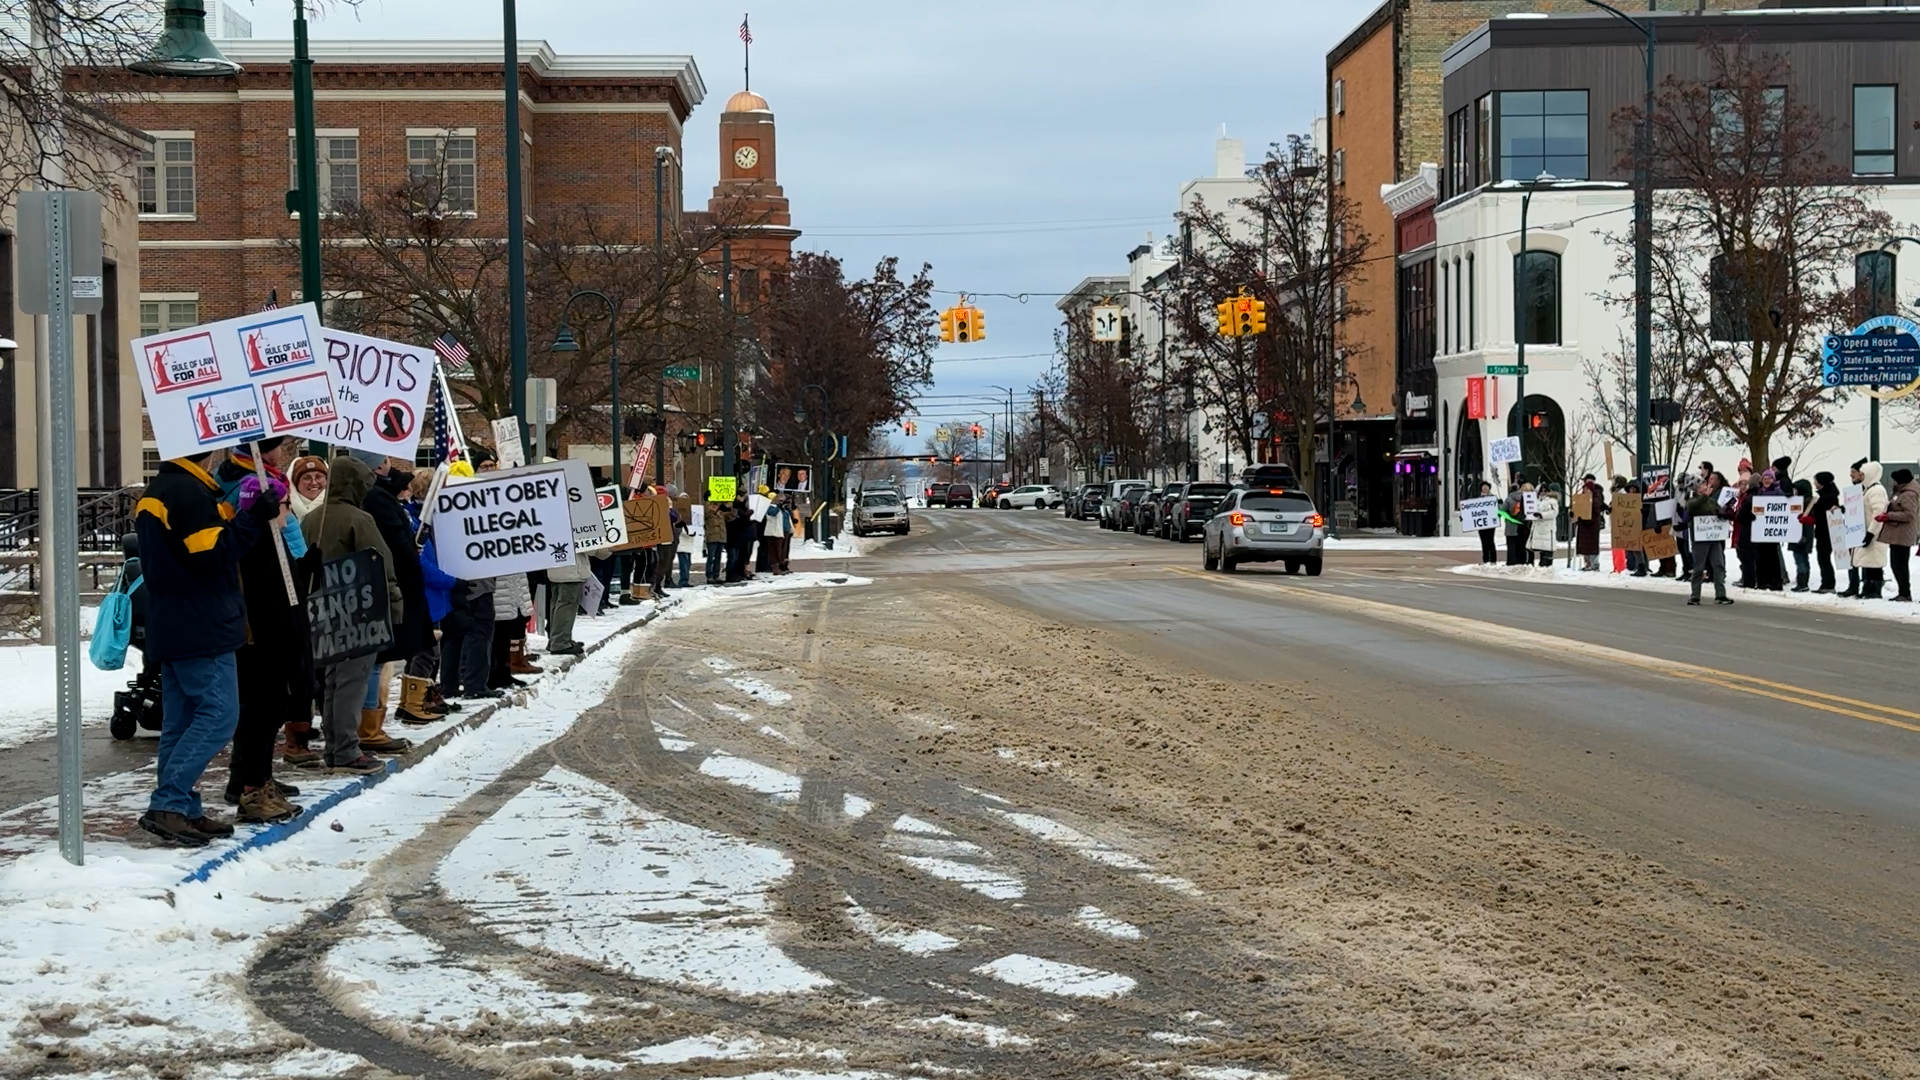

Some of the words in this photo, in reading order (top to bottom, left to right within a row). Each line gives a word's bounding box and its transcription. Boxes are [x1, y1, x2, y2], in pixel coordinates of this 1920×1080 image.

[264, 345, 282, 355] RULE
[282, 343, 291, 352] OF
[292, 340, 308, 349] LAW
[1843, 338, 1869, 349] Opera
[1872, 337, 1898, 347] House
[267, 353, 288, 365] FOR
[290, 349, 311, 361] ALL
[1843, 355, 1883, 365] State/Bijou
[1883, 354, 1915, 364] Theatres
[171, 362, 188, 372] RULE
[189, 361, 198, 369] OF
[198, 357, 215, 367] LAW
[323, 337, 420, 392] RIOTS
[174, 370, 195, 383] FOR
[197, 366, 218, 378] ALL
[1843, 371, 1912, 383] Beaches/Marina
[338, 385, 360, 403] the
[288, 402, 305, 411] RULE
[306, 400, 315, 408] OF
[315, 396, 331, 406] LAW
[214, 414, 232, 423] RULE
[232, 412, 241, 421] OF
[241, 409, 257, 418] LAW
[290, 409, 312, 422] FOR
[313, 405, 334, 417] ALL
[216, 422, 238, 434] FOR
[240, 417, 260, 429] ALL
[1642, 470, 1652, 478] NO
[1652, 468, 1670, 477] KINGS
[438, 486, 500, 513] DON'T
[505, 477, 560, 503] OBEY
[1642, 491, 1670, 500] AMERICA
[1460, 499, 1498, 510] Democracy
[1766, 502, 1788, 512] FIGHT
[1471, 509, 1488, 517] Melts
[463, 507, 543, 536] ILLEGAL
[1473, 517, 1488, 528] ICE
[1617, 519, 1634, 528] LAW
[1765, 516, 1789, 525] TRUTH
[1763, 528, 1788, 537] DECAY
[465, 532, 547, 561] ORDERS
[323, 559, 357, 588] NO
